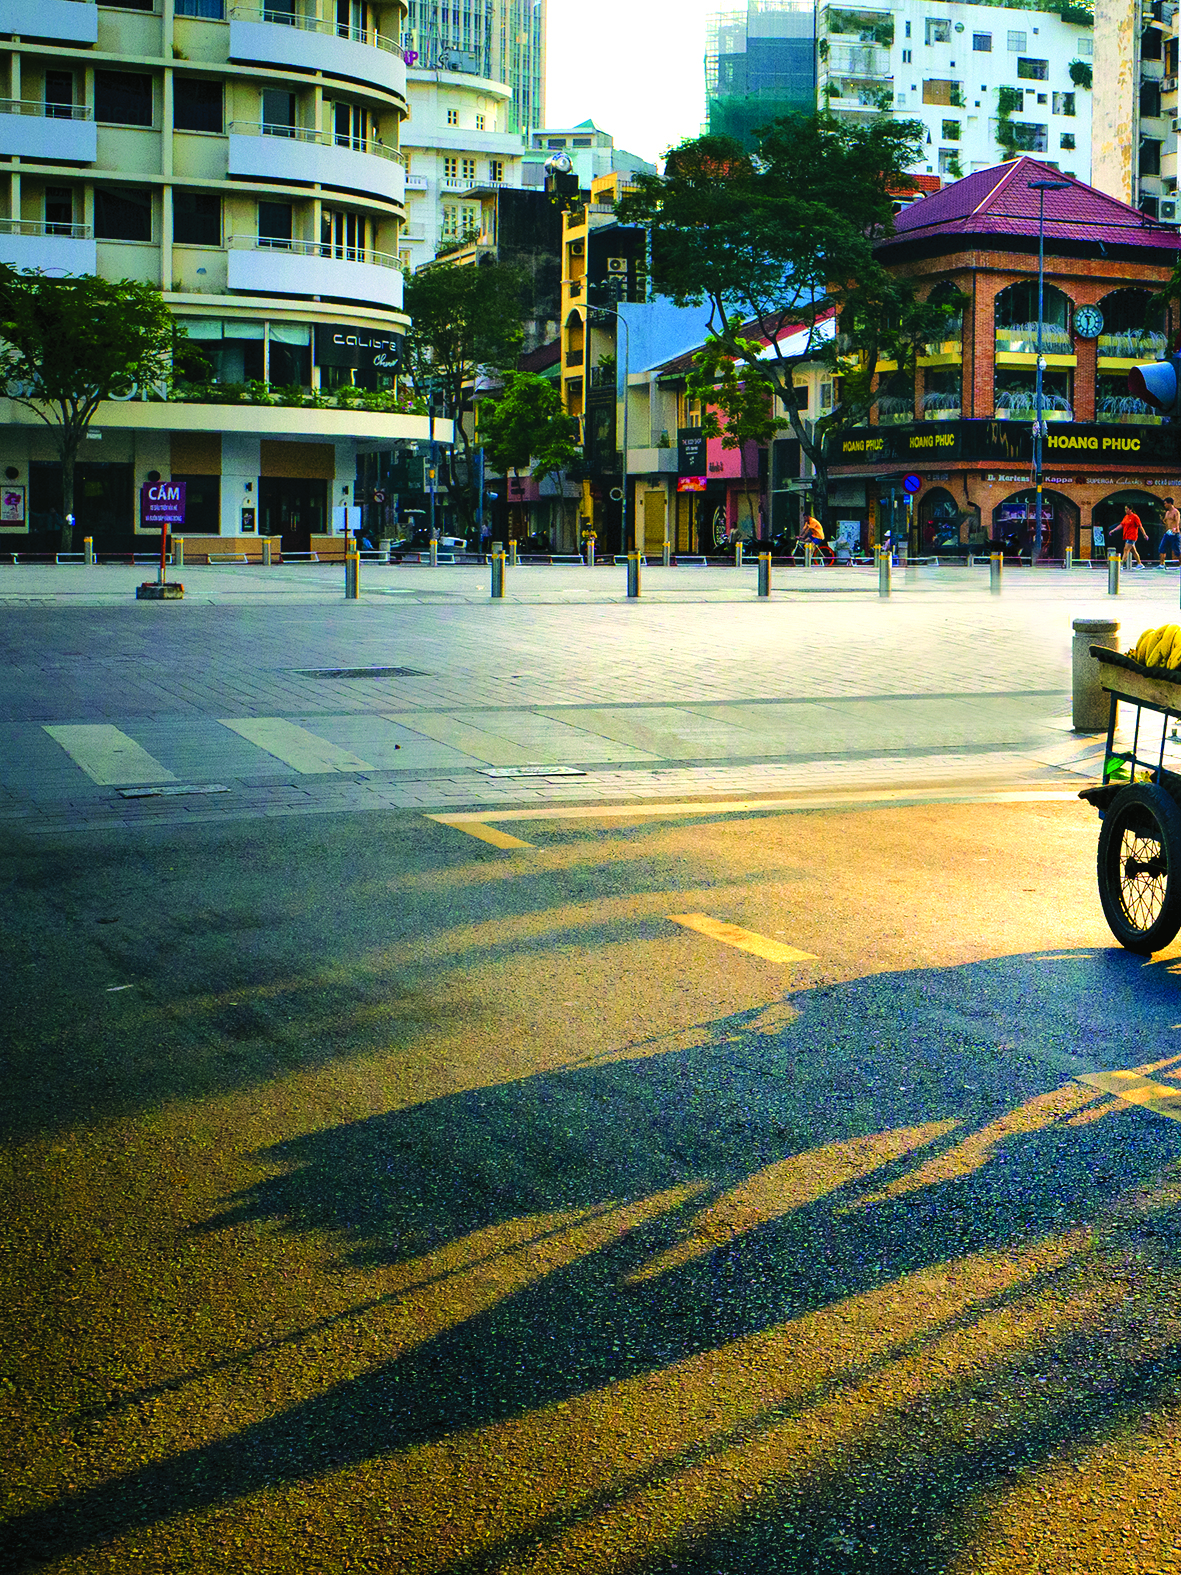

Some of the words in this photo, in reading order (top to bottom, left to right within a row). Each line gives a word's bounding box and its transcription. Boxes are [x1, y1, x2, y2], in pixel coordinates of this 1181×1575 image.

[909, 435, 934, 449] HOANG
[934, 433, 955, 447] PHUC
[1048, 435, 1099, 450] HOANG
[1102, 437, 1141, 451] PHUC
[148, 482, 180, 500] CẤM
